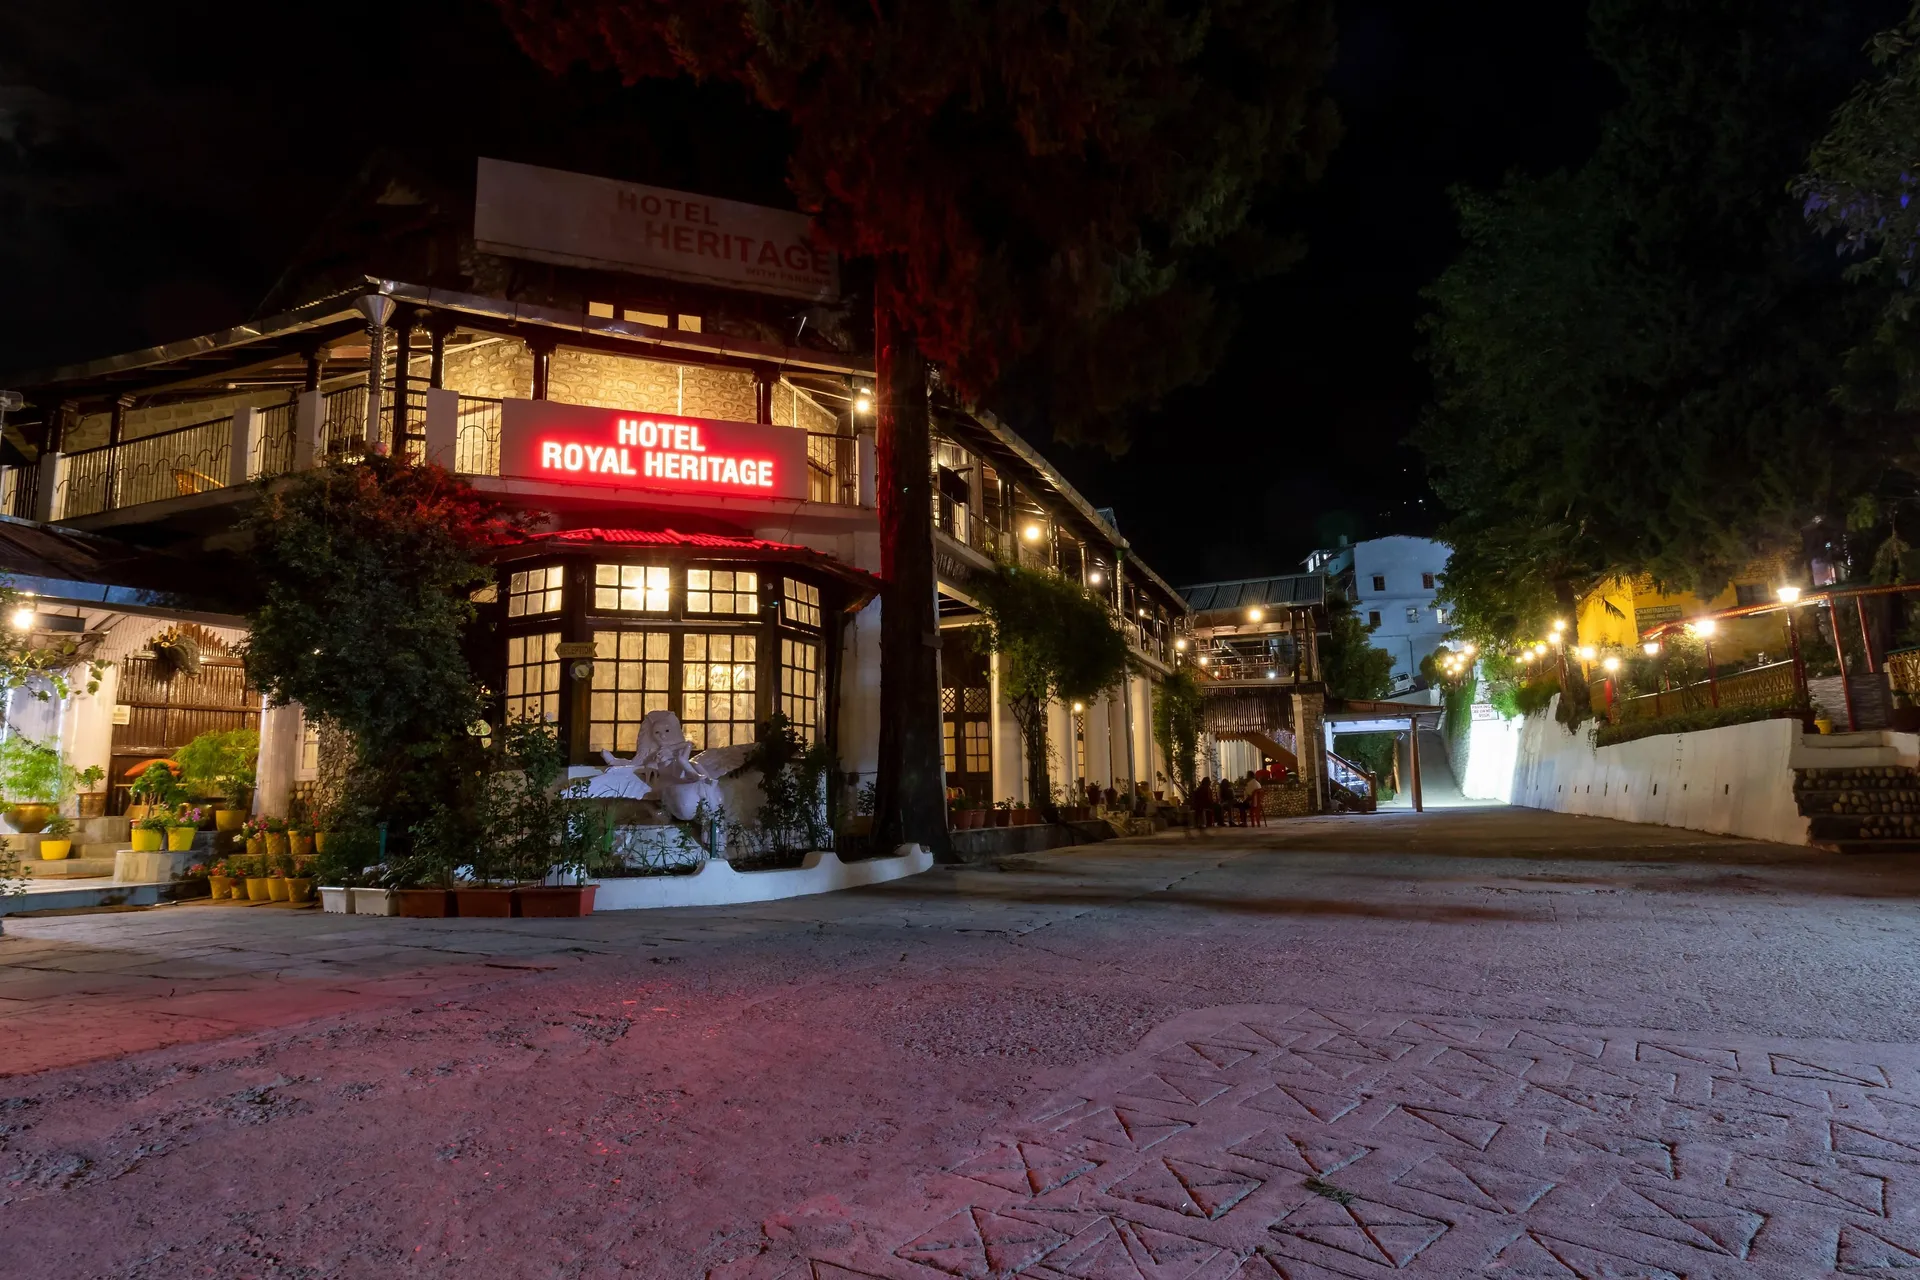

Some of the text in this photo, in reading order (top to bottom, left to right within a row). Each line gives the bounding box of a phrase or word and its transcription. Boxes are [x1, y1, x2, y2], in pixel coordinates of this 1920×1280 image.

[617, 190, 719, 227] HOTEL
[645, 219, 832, 276] HERITAGE
[745, 267, 831, 286] WITH PARKING
[618, 419, 706, 452] HOTEL
[541, 441, 774, 487] ROYAL HERITAGE
